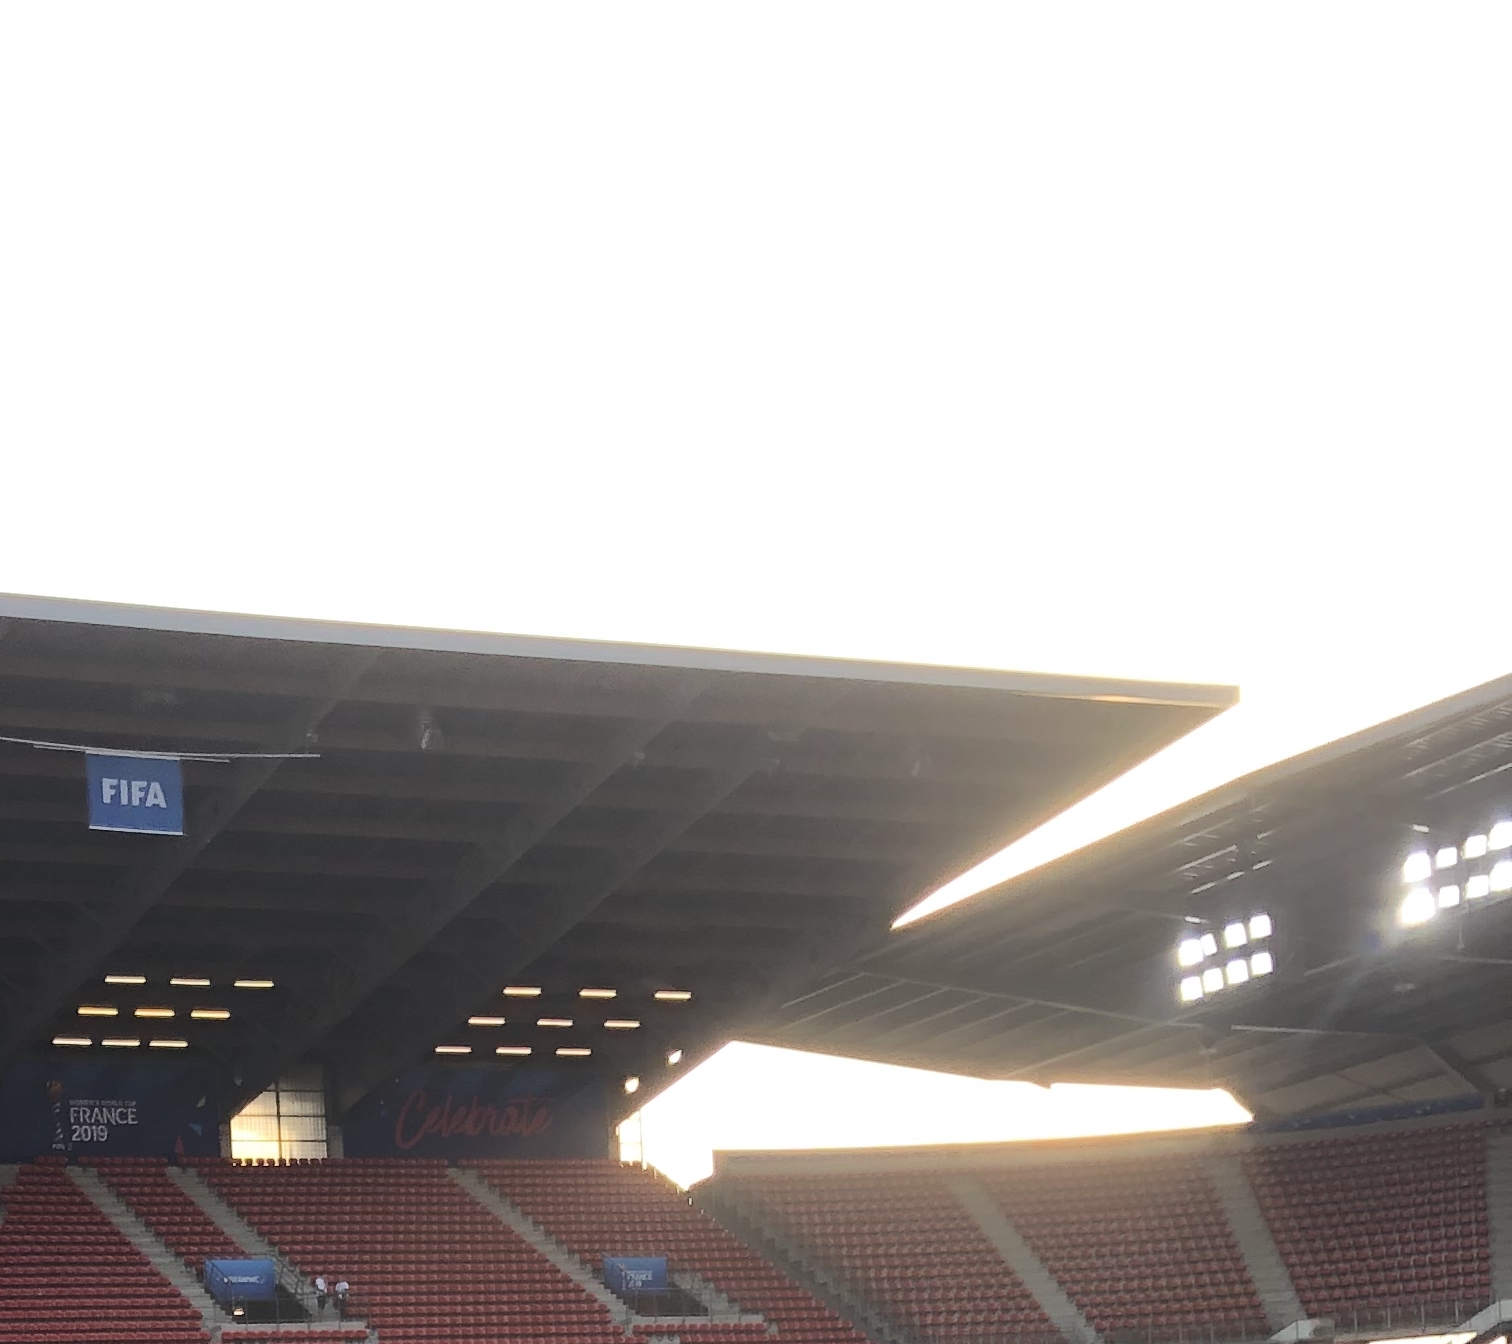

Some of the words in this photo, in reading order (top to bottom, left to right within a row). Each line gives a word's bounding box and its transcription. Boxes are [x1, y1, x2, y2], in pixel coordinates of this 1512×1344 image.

[101, 777, 167, 809] FIFA
[69, 1107, 138, 1125] FRANCE
[395, 1089, 554, 1150] Celebrate
[71, 1125, 109, 1142] 2019
